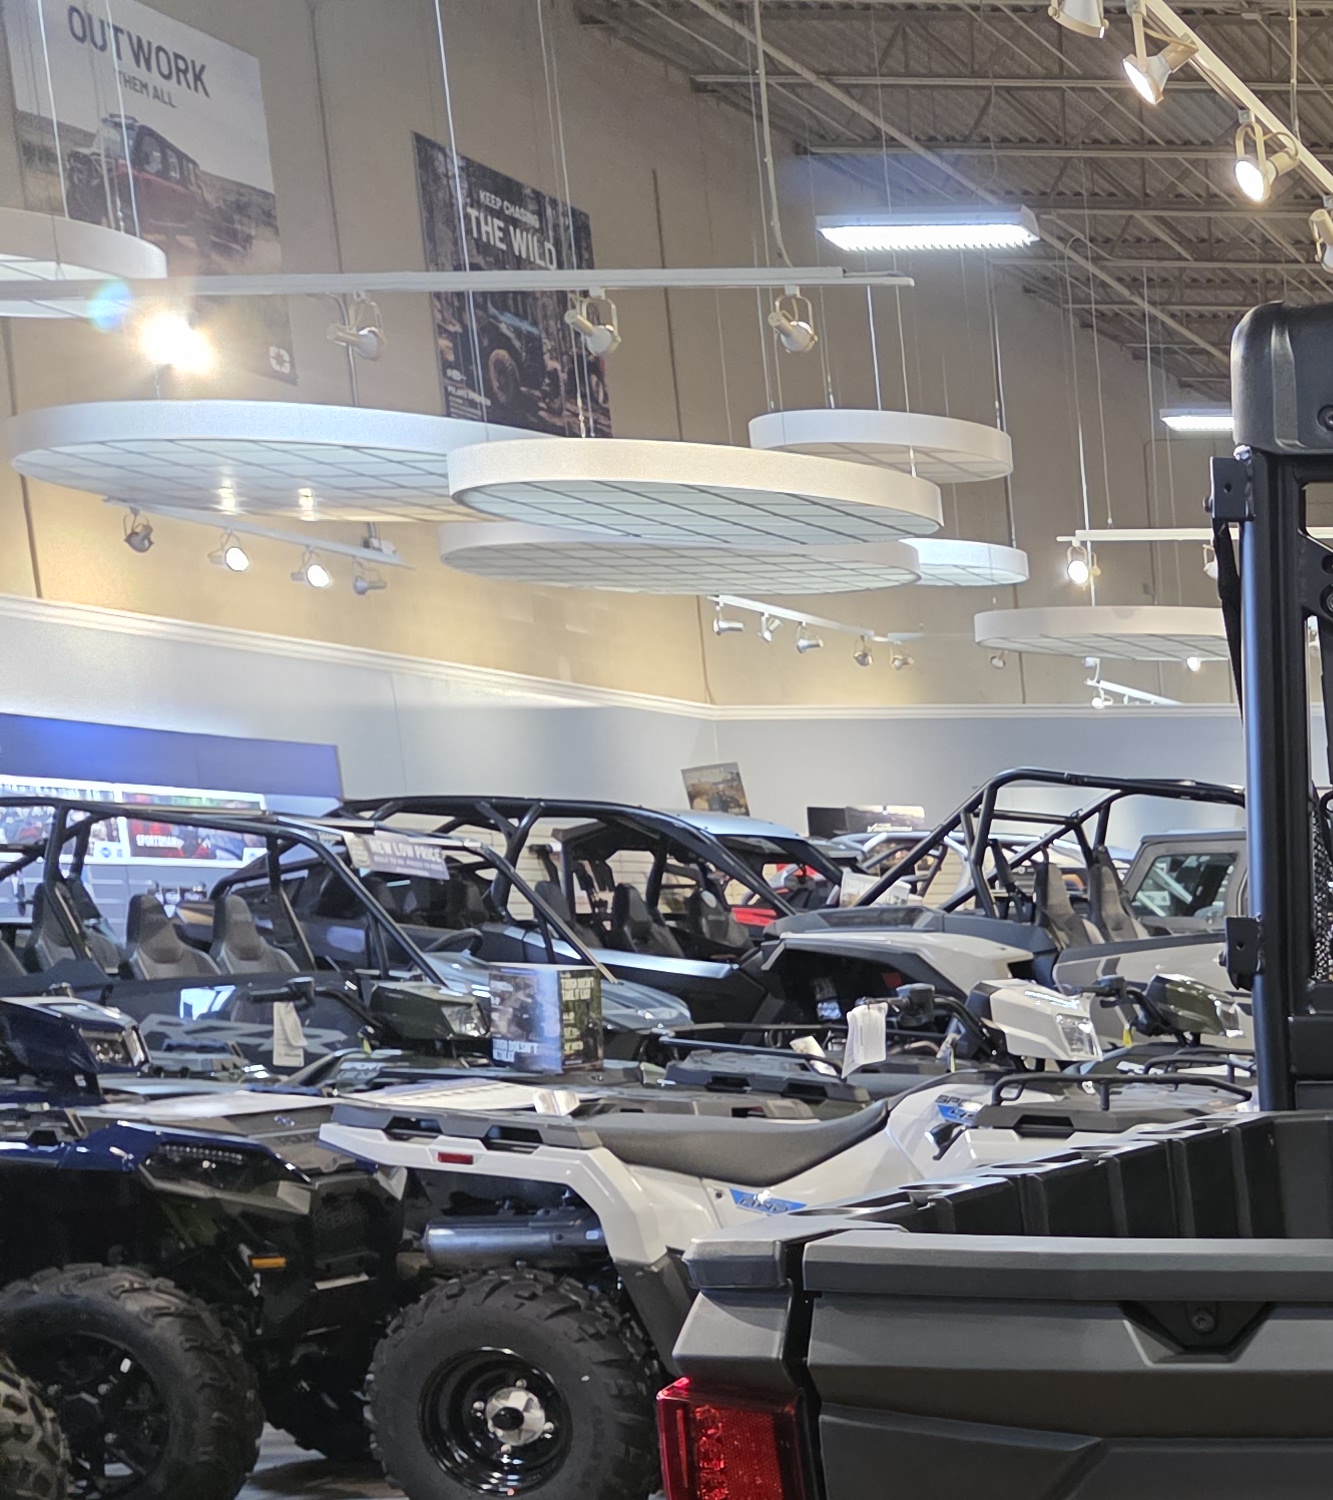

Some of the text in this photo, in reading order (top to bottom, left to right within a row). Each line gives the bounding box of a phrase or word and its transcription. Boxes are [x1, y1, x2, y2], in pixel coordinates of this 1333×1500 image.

[67, 5, 210, 98] OUTWORK
[114, 69, 177, 108] THEM ALL
[480, 190, 502, 209] KEEP
[467, 206, 557, 271] THE WILD
[369, 839, 392, 855] NEW
